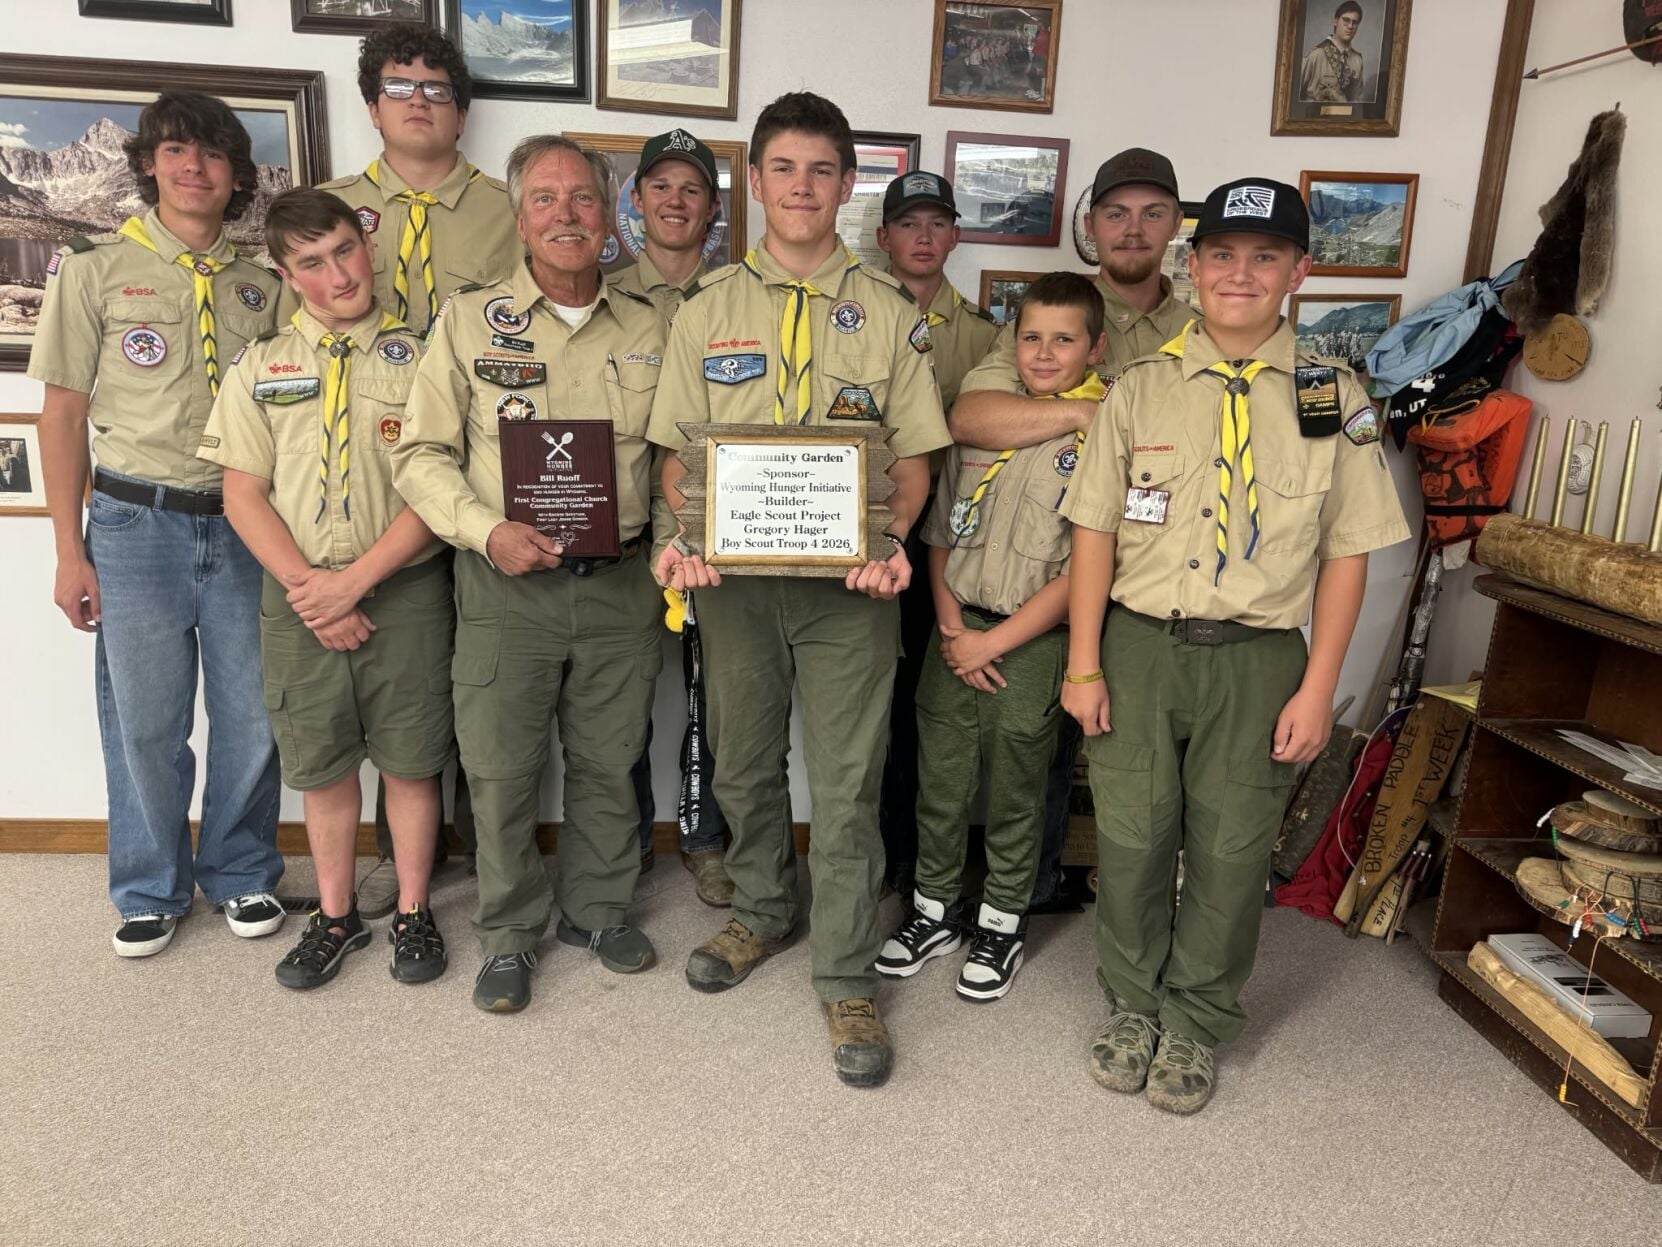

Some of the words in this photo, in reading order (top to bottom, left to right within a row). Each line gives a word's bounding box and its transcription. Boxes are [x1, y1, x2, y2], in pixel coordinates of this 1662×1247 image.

[135, 288, 158, 296] BSA
[282, 365, 303, 373] BSA
[1408, 398, 1428, 413] UT
[728, 451, 798, 465] Community
[801, 452, 844, 463] Garden
[540, 474, 555, 482] Bill
[557, 474, 581, 482] Ruoff
[720, 481, 767, 494] Wyoming
[769, 482, 807, 494] Hunger
[809, 482, 853, 493] Initiative
[531, 496, 583, 504] Congregational
[730, 509, 762, 522] Eagle
[764, 510, 798, 521] Scout
[801, 510, 842, 523] Project
[743, 523, 791, 537] Gregory
[794, 524, 829, 537] Hager
[721, 537, 742, 550] Boy
[744, 538, 775, 549] Scout
[776, 538, 808, 551] Troop
[810, 538, 818, 549] 4
[821, 538, 851, 549] 2026
[1423, 723, 1460, 782] WEEK
[1363, 803, 1393, 874] BROKEN
[1383, 725, 1421, 790] PADDLE
